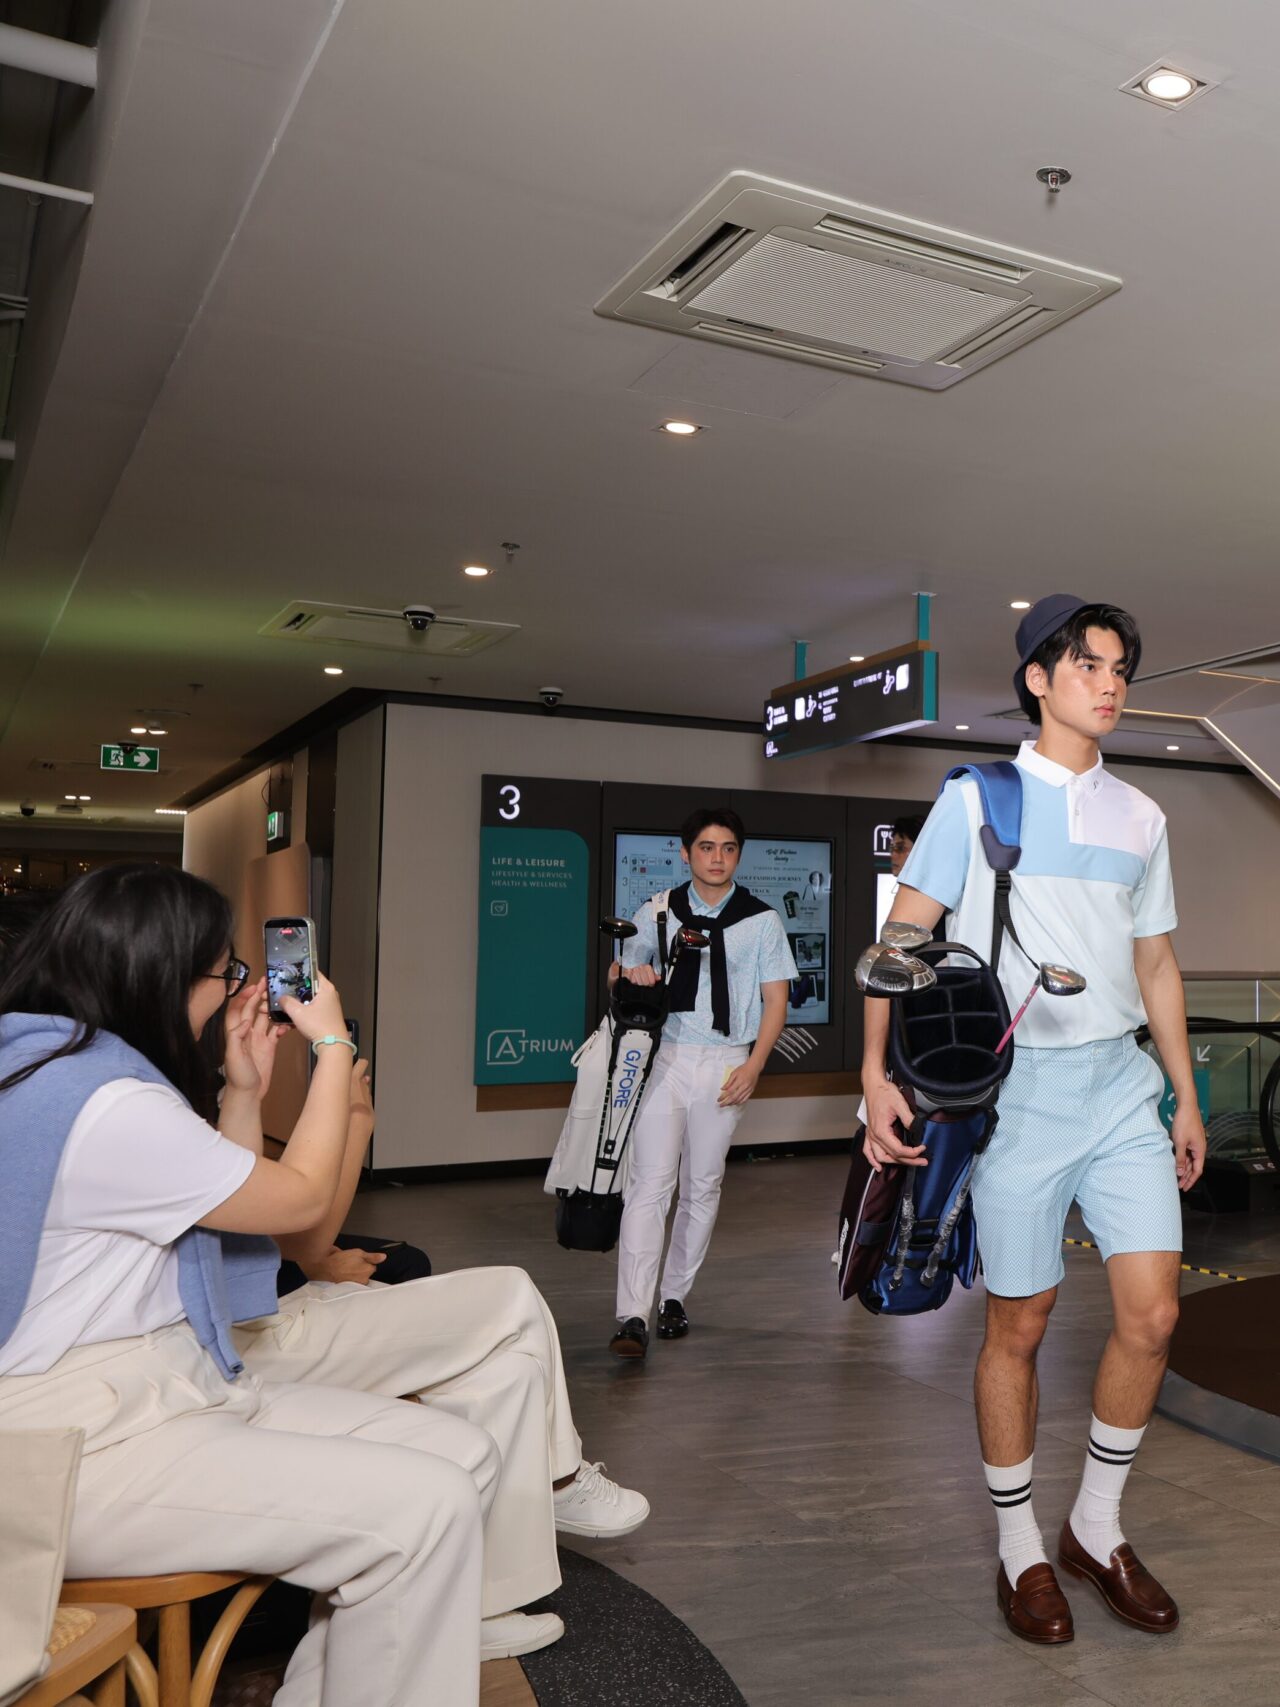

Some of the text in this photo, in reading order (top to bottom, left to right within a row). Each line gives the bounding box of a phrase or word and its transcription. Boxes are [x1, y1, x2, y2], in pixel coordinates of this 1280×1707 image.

[499, 785, 521, 820] 3
[492, 857, 566, 868] LIFE & LEISURE
[491, 870, 528, 878] LIFESTYLE
[537, 871, 573, 879] SERVICES
[491, 879, 521, 887] HEALTH
[529, 880, 568, 888] WELLNESS
[622, 877, 628, 887] 3
[495, 1036, 575, 1058] ATRIUM
[613, 1049, 641, 1109] G/FORE
